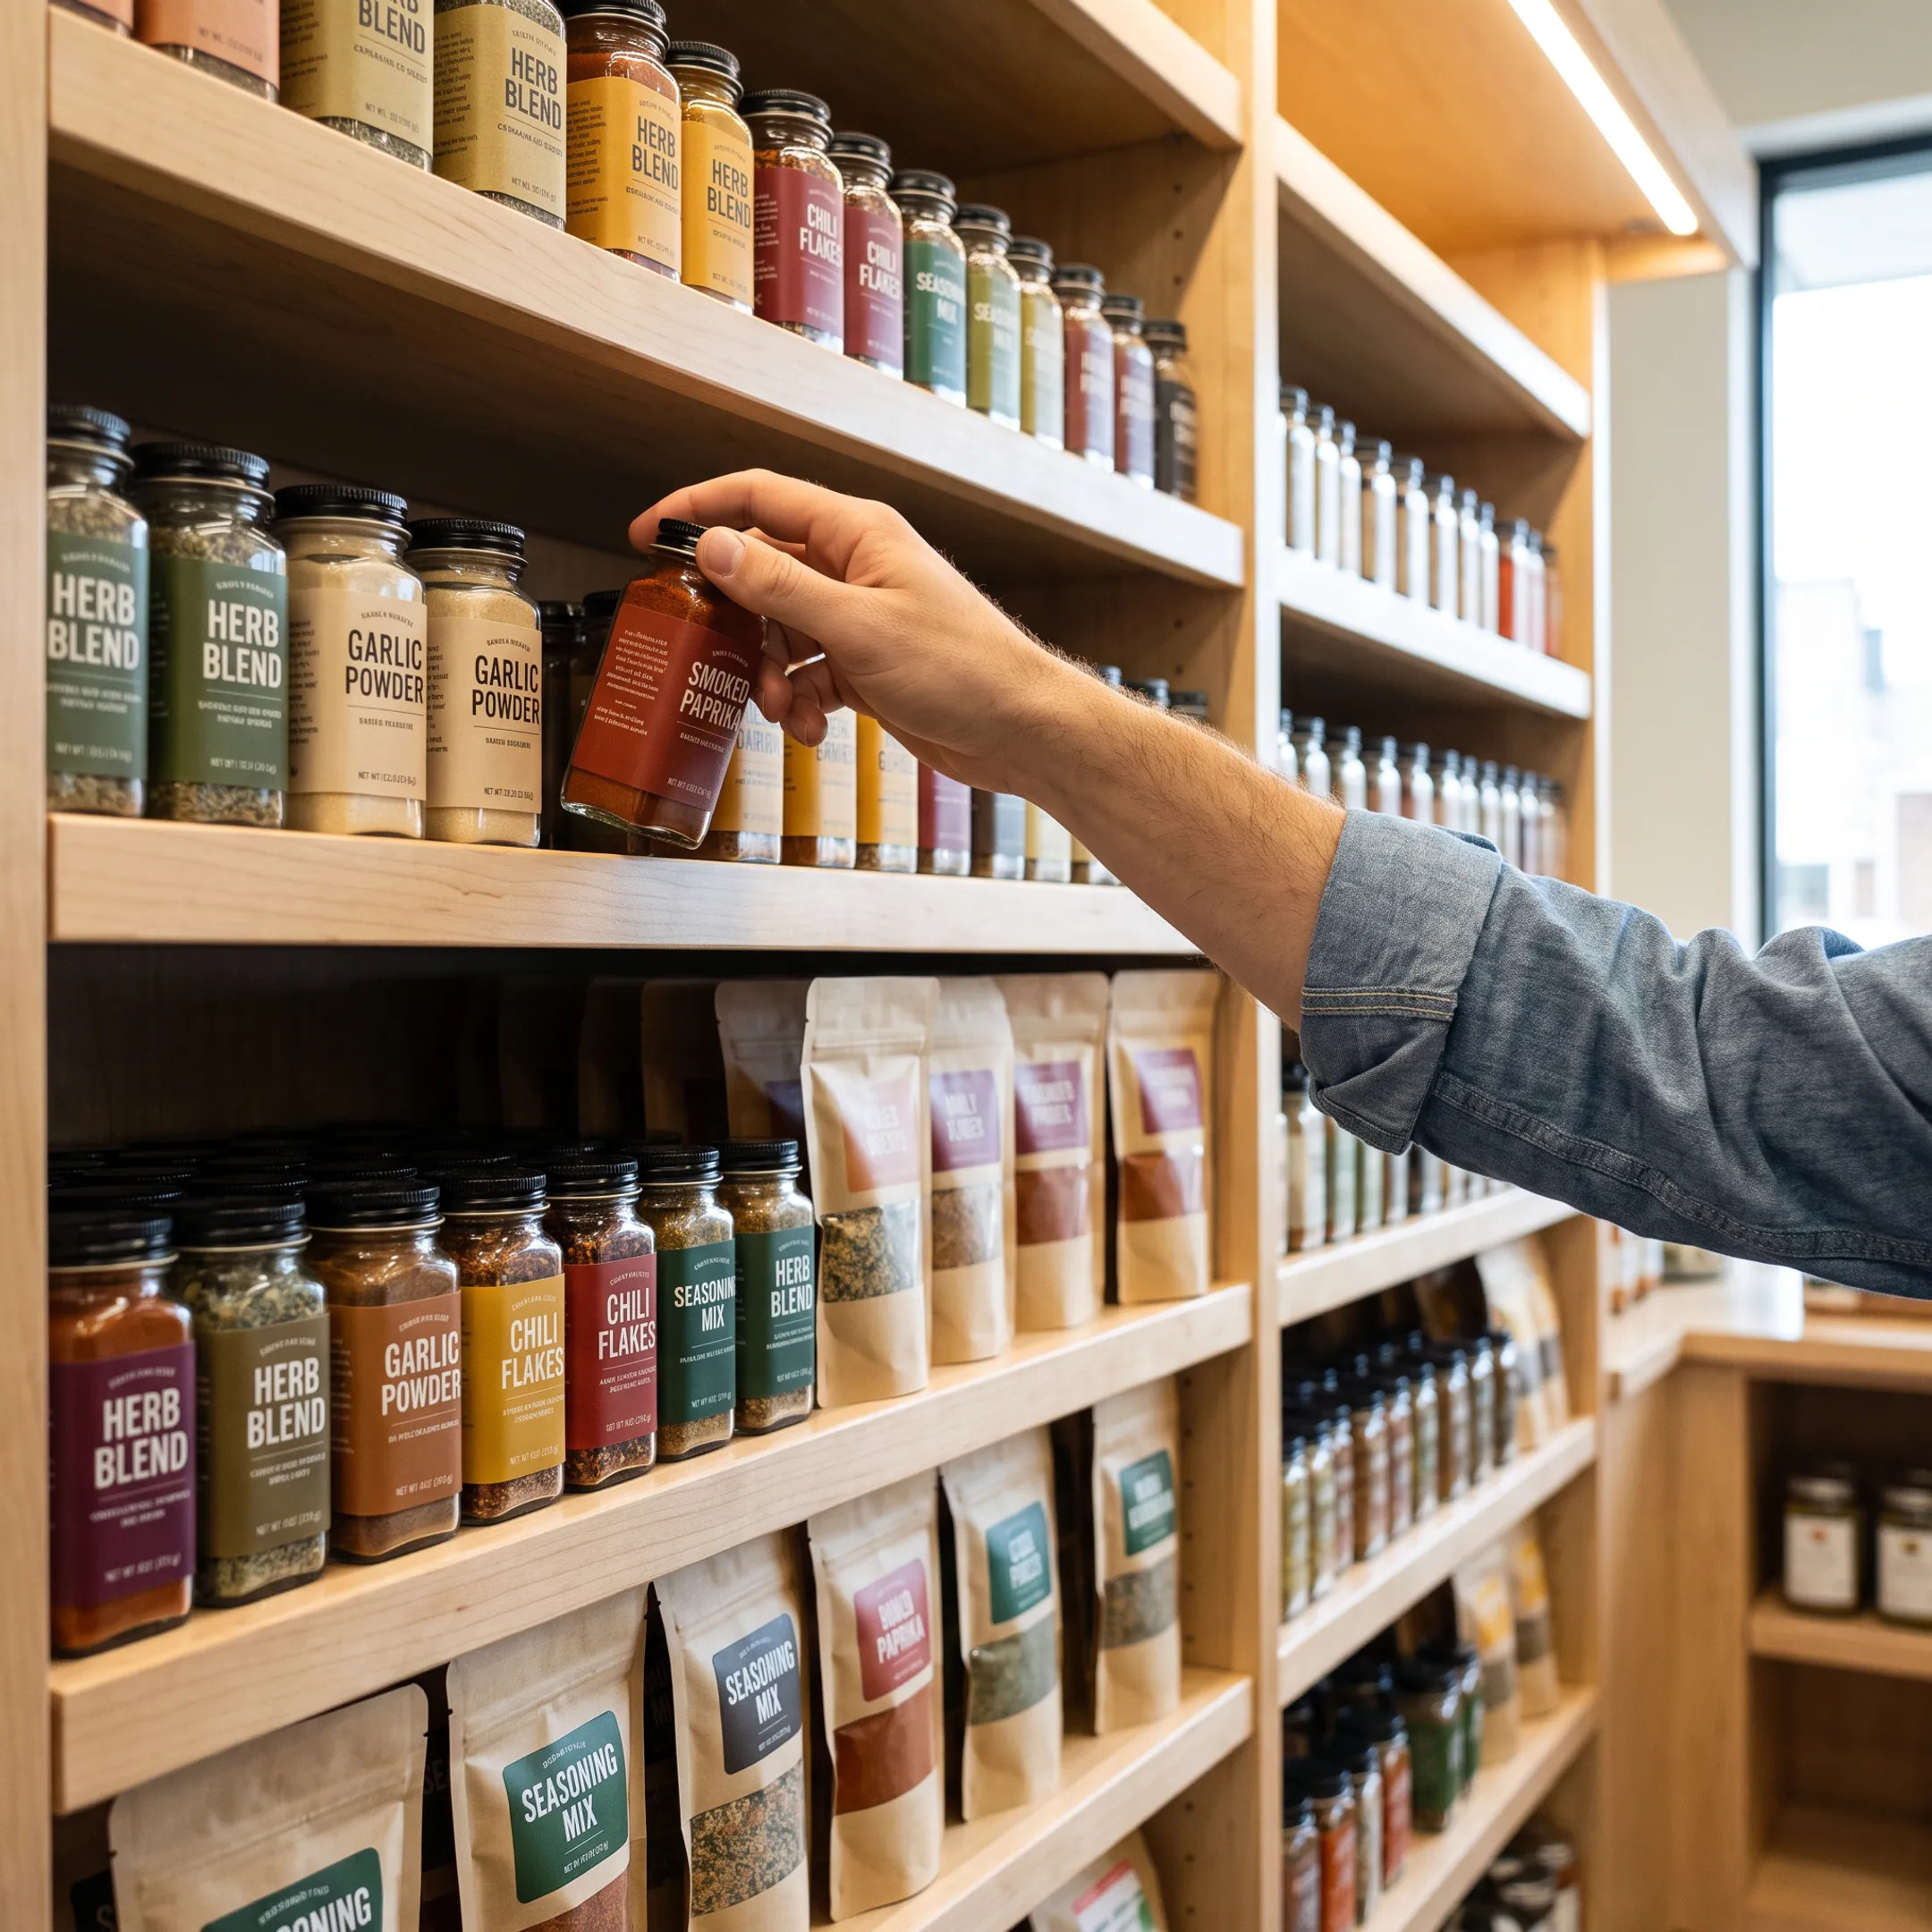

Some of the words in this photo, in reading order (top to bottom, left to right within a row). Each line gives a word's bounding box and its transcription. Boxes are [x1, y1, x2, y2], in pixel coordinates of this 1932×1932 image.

[359, 0, 425, 55] BLEND
[512, 47, 558, 95] HERB
[505, 78, 562, 130] BLEND
[637, 115, 675, 158] HERB
[631, 144, 679, 191] BLEND
[712, 158, 749, 199] HERB
[708, 186, 751, 229] BLEND
[807, 203, 837, 239] CHILI
[800, 226, 842, 268] FLAKES
[867, 241, 896, 274] CHILI
[52, 571, 136, 626] HERB
[47, 618, 140, 670] BLEND
[208, 599, 280, 648] HERB
[202, 641, 283, 689] BLEND
[348, 629, 423, 670] GARLIC
[345, 665, 425, 704] POWDER
[475, 655, 539, 693] GARLIC
[688, 661, 750, 704] SMOKED
[472, 689, 540, 724] POWDER
[679, 689, 745, 732] PAPRIKA
[775, 1255, 811, 1288] HERB
[607, 1288, 649, 1325] CHILI
[701, 1303, 724, 1332] MIX
[770, 1284, 813, 1318] BLEND
[510, 1312, 558, 1352] CHILI
[598, 1321, 656, 1360] FLAKES
[385, 1331, 459, 1378] GARLIC
[502, 1346, 564, 1390] FLAKES
[254, 1357, 320, 1406] HERB
[381, 1368, 461, 1416] POWDER
[103, 1387, 180, 1443] HERB
[247, 1397, 326, 1449] BLEND
[94, 1430, 189, 1489] BLEND
[725, 1640, 795, 1706] SEASONING
[755, 1683, 782, 1724] MIX
[521, 1742, 618, 1823] SEASONING
[562, 1793, 598, 1842] MIX
